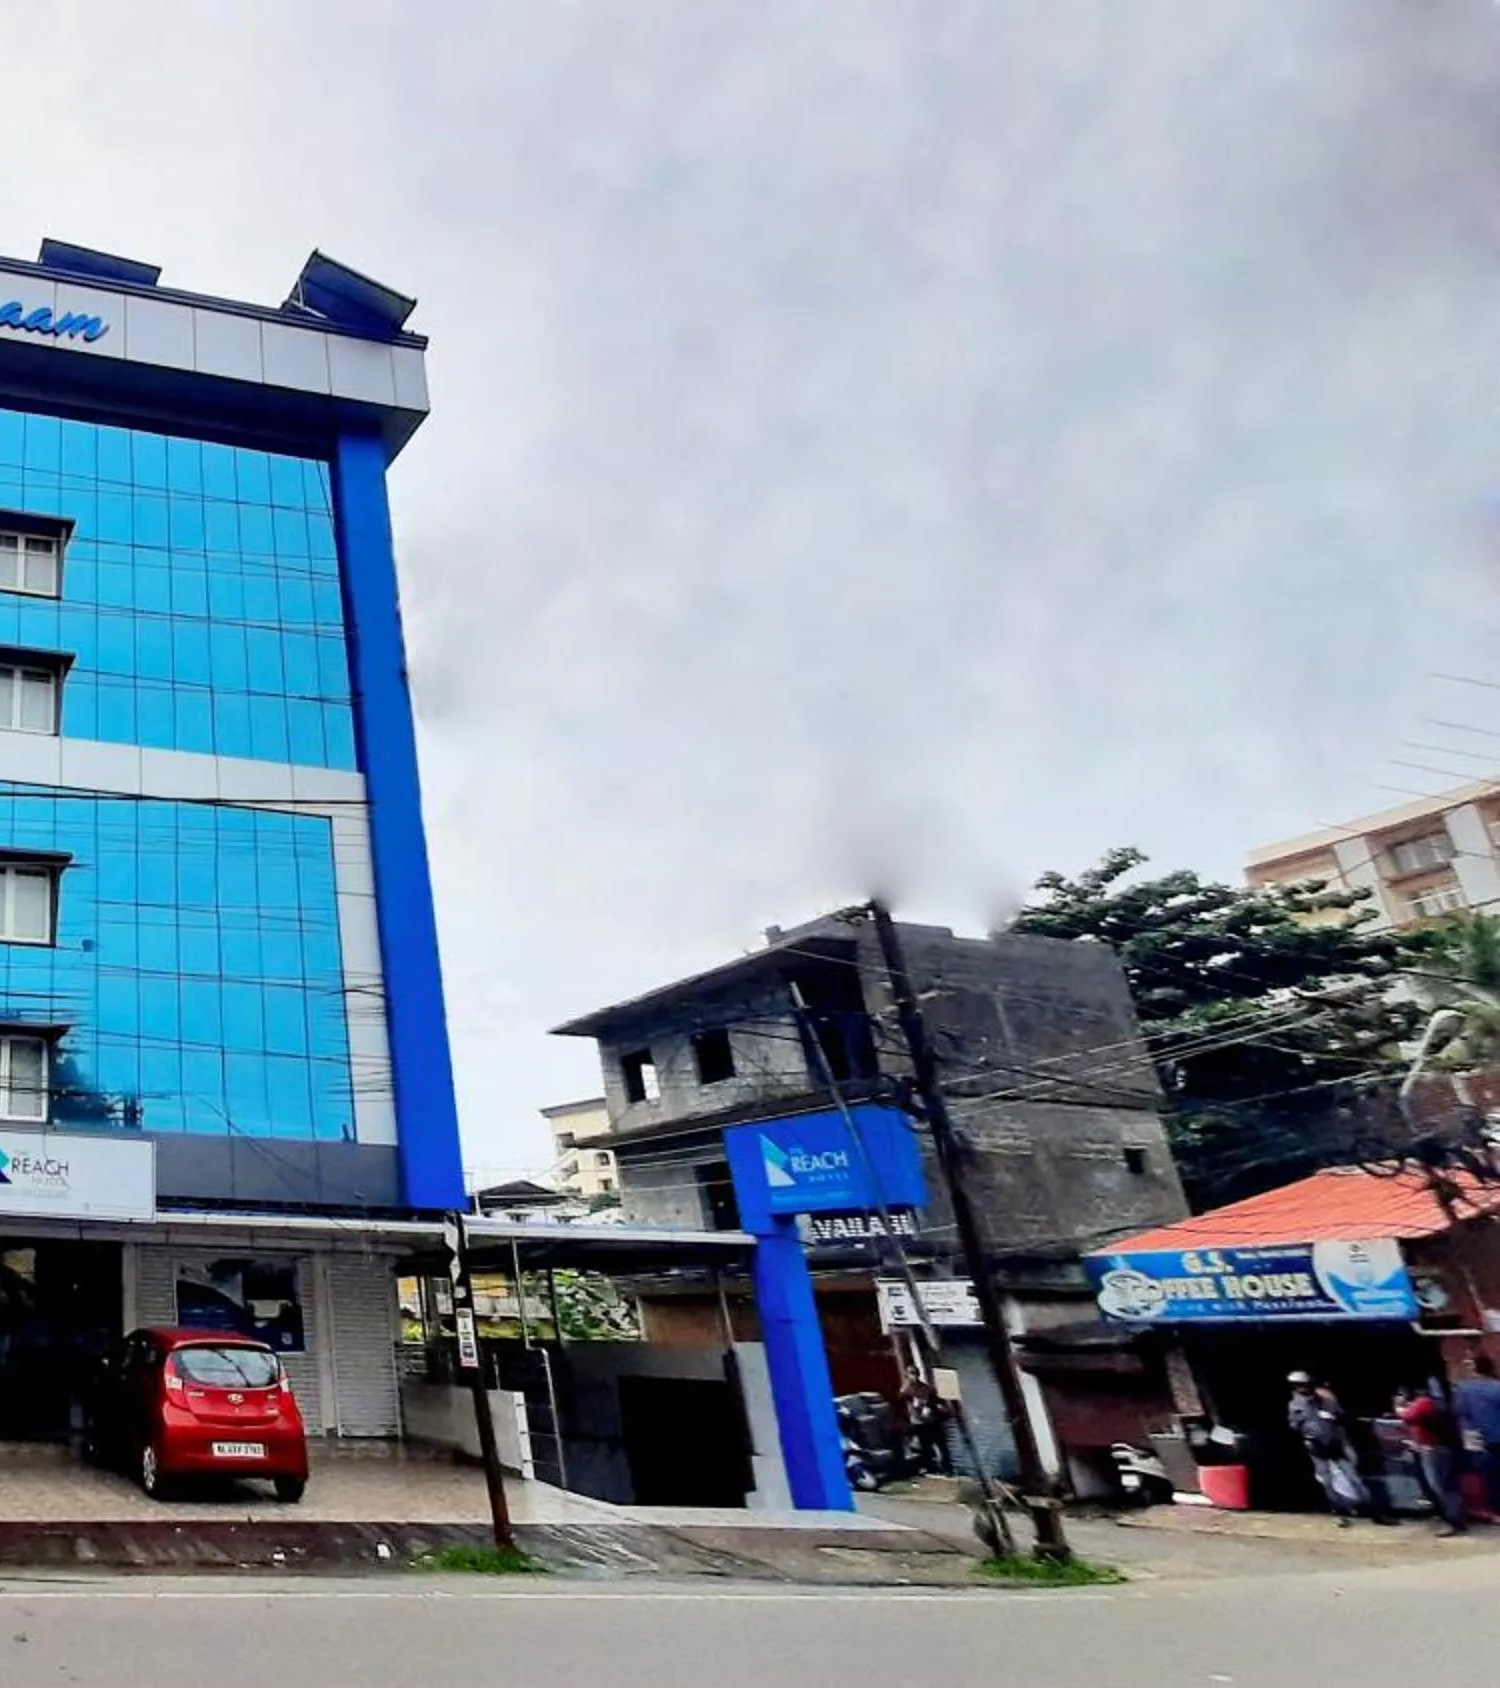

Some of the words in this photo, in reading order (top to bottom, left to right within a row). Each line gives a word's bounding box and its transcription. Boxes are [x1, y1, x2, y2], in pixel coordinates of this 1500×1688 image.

[11, 1157, 69, 1177] REACH
[790, 1151, 849, 1173] REACH
[1222, 1273, 1316, 1300] HOUSE
